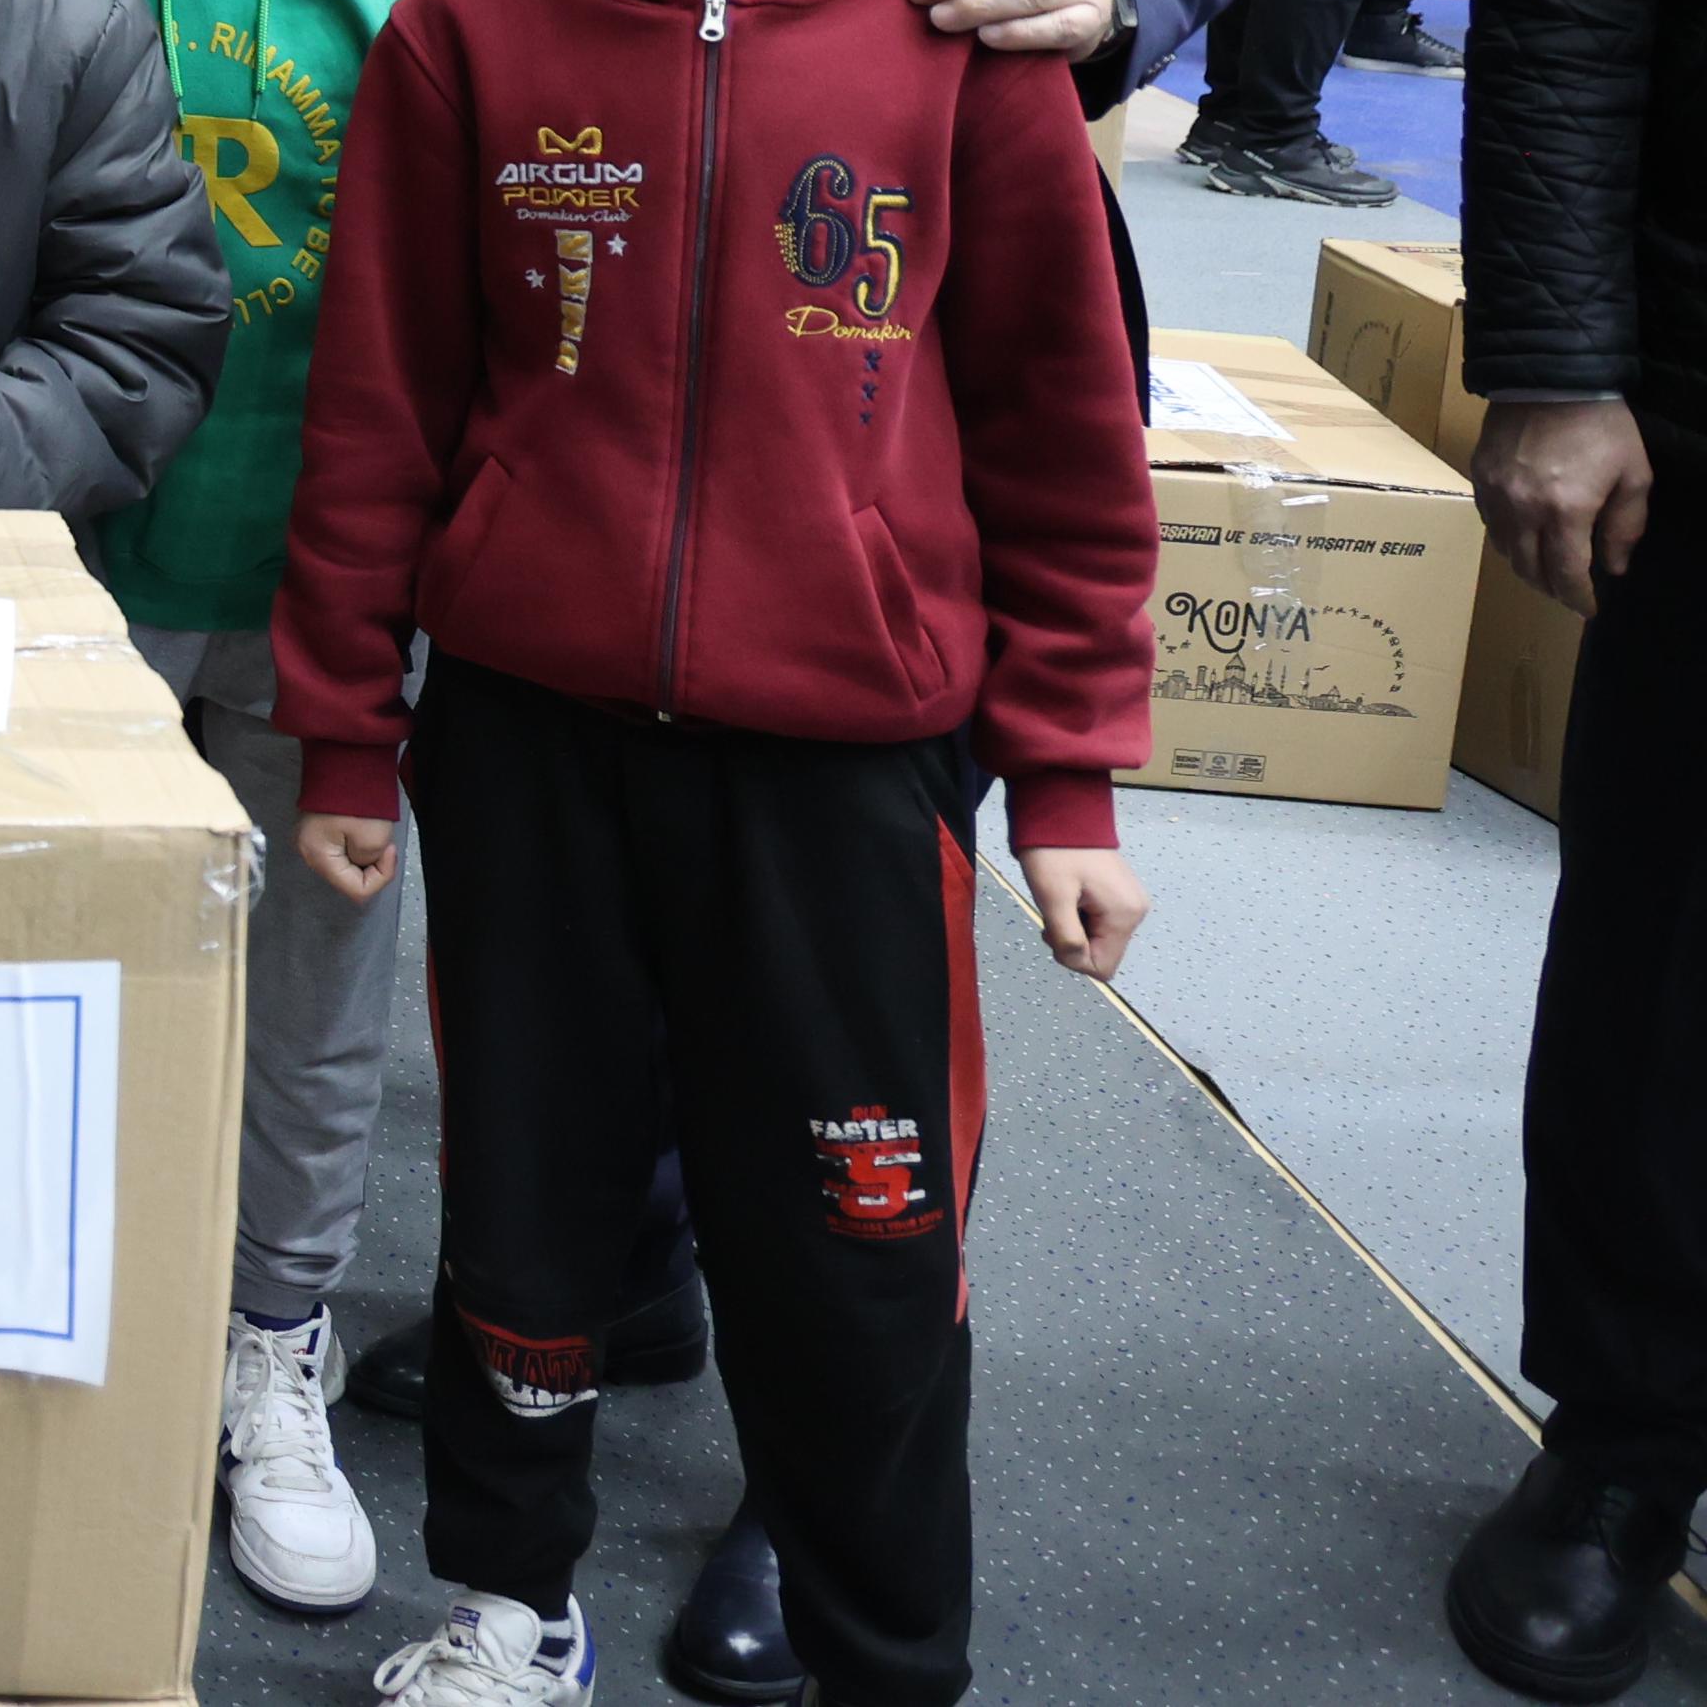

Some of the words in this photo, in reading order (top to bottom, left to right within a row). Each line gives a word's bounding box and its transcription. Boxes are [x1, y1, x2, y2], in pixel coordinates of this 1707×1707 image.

[502, 187, 640, 208] POWER
[775, 154, 915, 321] 65
[786, 305, 914, 343] Domakin
[1159, 524, 1220, 542] AŞAYAN
[1306, 536, 1377, 554] YAŞATAN
[1165, 592, 1311, 654] KONYA
